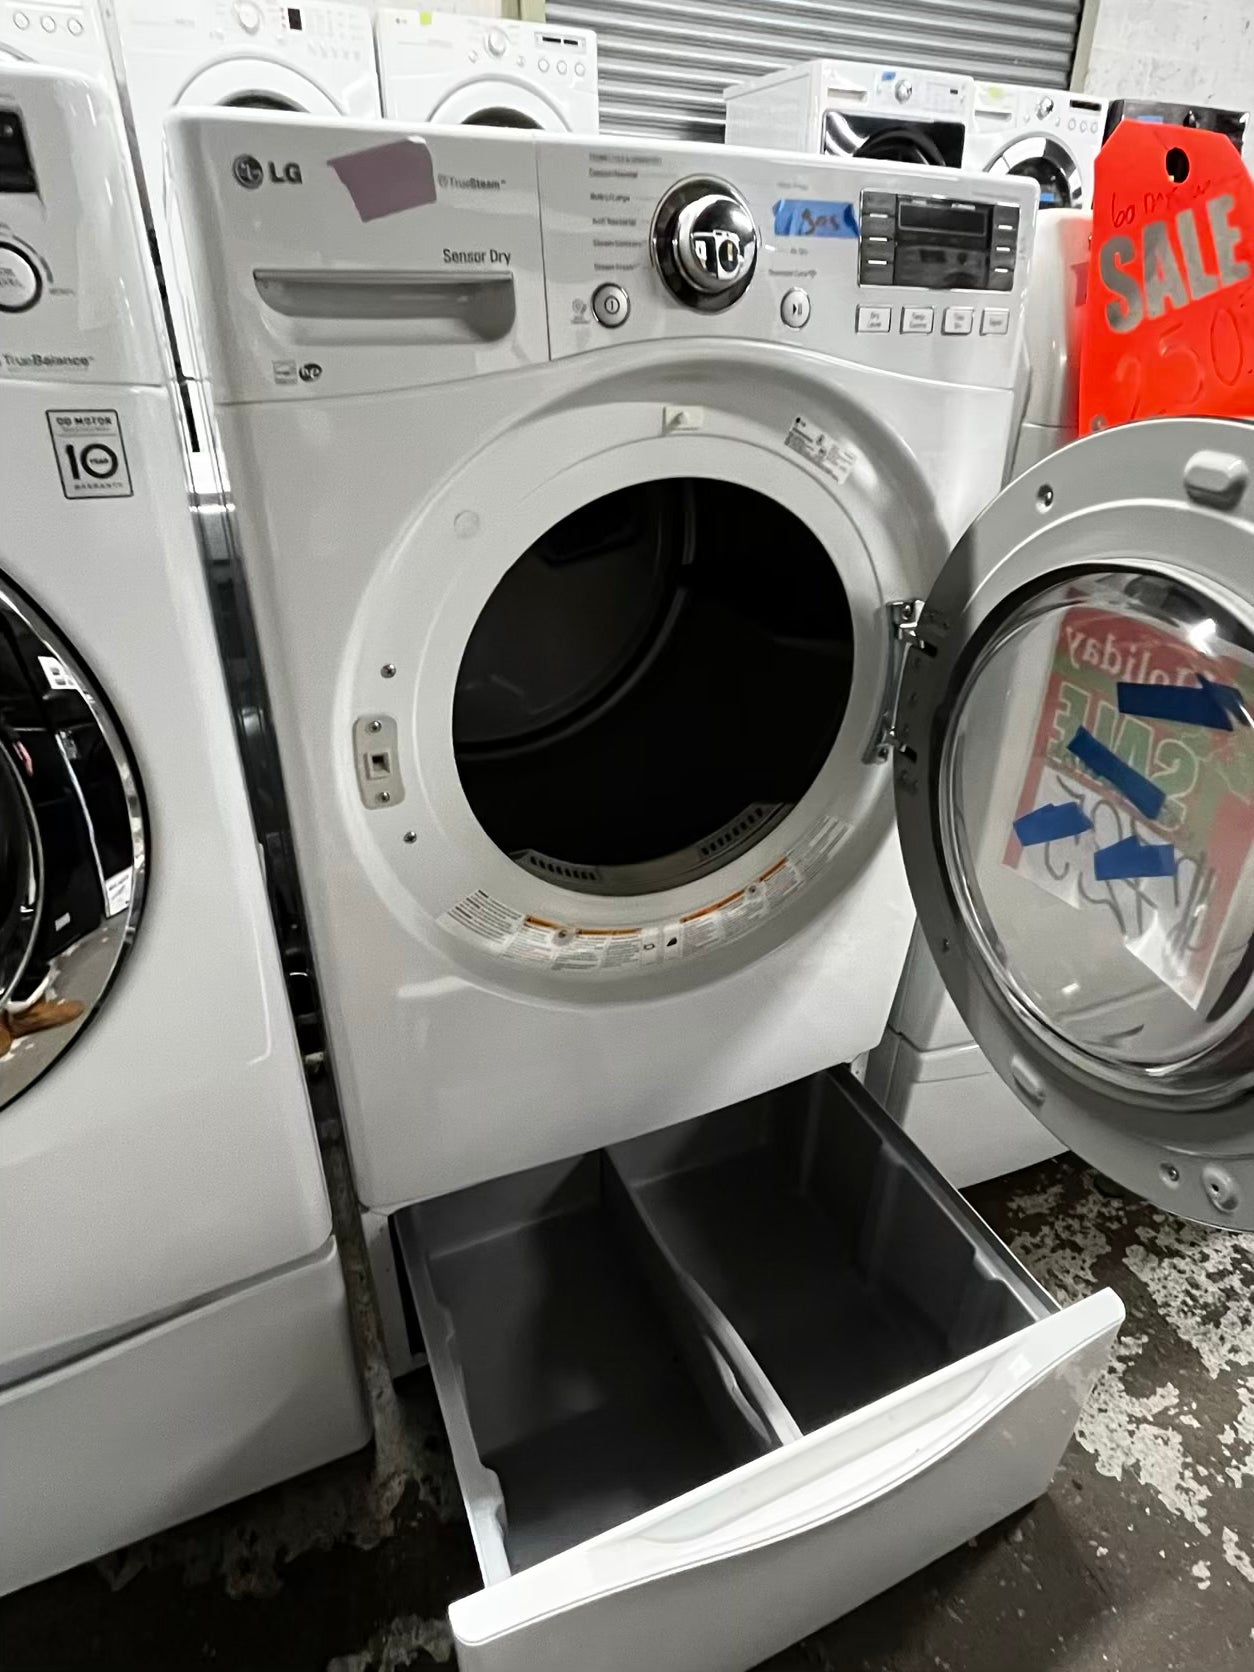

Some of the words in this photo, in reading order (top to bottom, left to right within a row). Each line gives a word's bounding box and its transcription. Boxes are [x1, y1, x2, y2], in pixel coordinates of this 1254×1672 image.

[268, 162, 303, 184] LG
[442, 248, 486, 264] Sensor
[489, 248, 512, 267] Dry
[1099, 193, 1251, 335] SALE
[75, 416, 112, 425] MOTOR
[65, 443, 119, 480] 10
